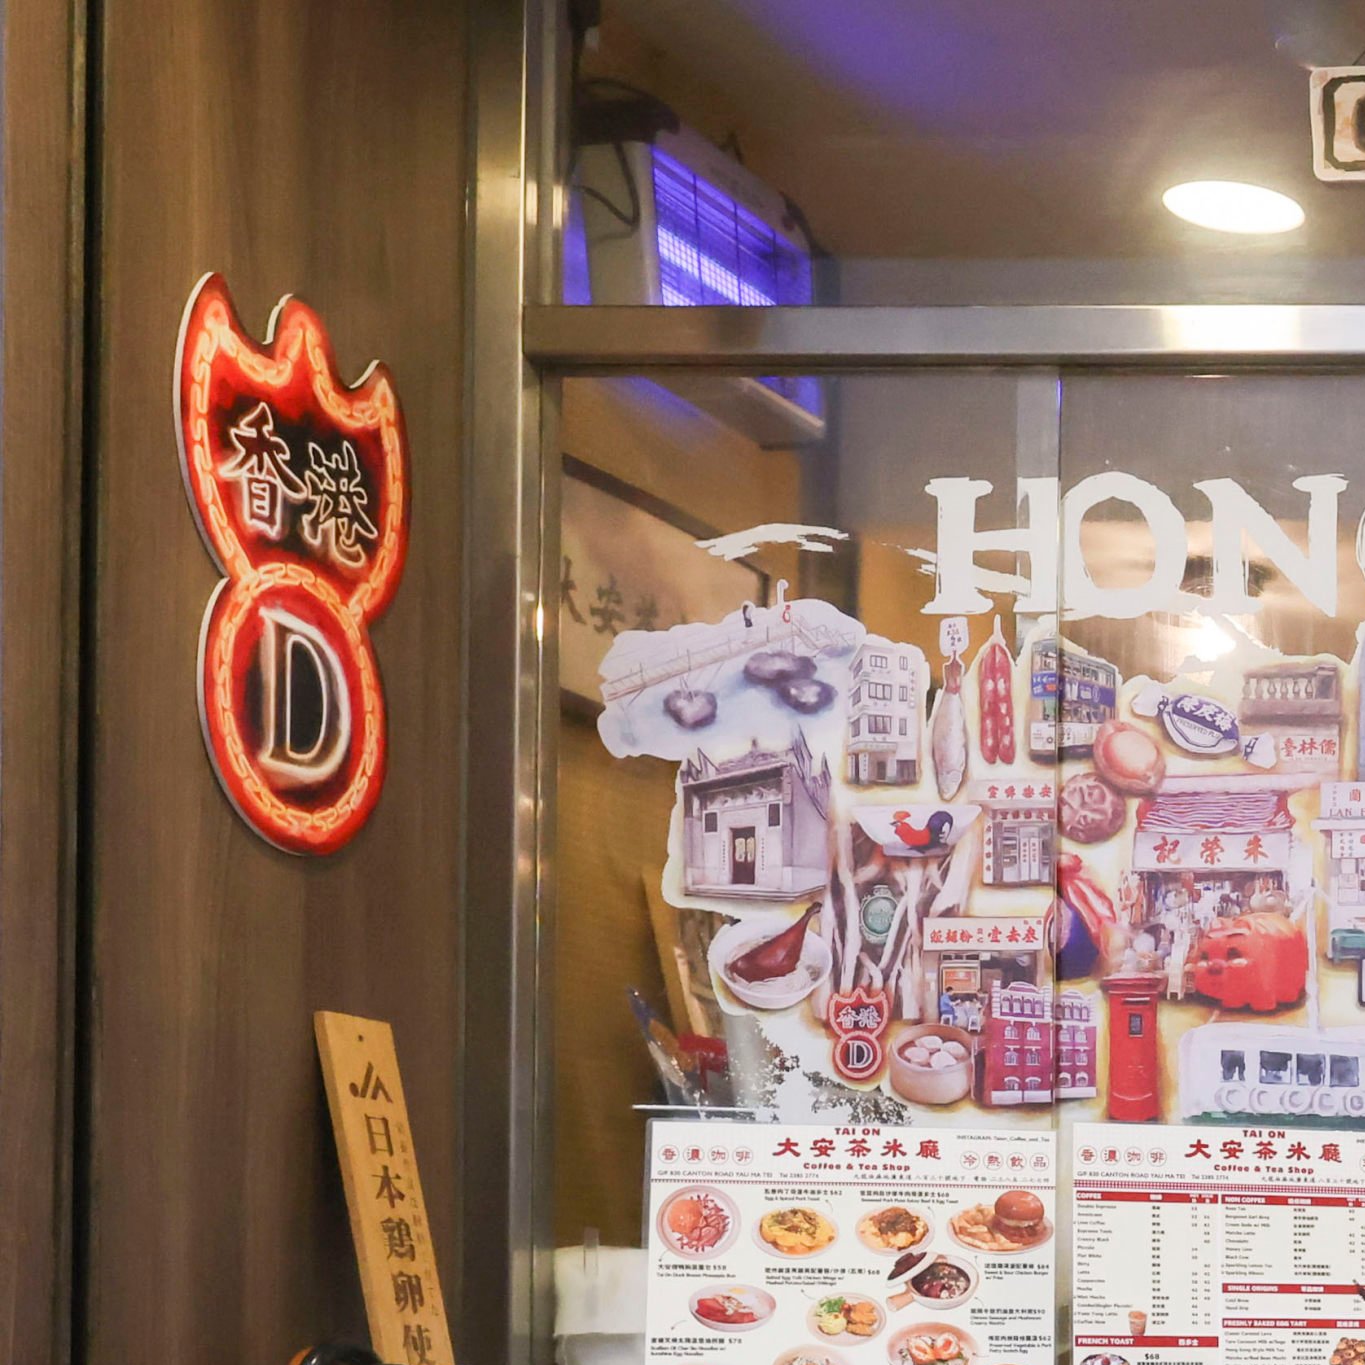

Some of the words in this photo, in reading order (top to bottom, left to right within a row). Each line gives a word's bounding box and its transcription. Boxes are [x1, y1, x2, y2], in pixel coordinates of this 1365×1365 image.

[221, 401, 378, 567] 香港
[257, 606, 352, 784] D
[1329, 808, 1352, 817] LAN
[848, 1038, 872, 1070] D
[834, 1127, 857, 1136] TAI
[861, 1127, 881, 1137] ON
[1242, 1129, 1263, 1139] TAI
[1268, 1130, 1286, 1139] ON
[803, 1162, 842, 1170] Coffee
[846, 1162, 854, 1170] &
[858, 1163, 878, 1171] Tea
[882, 1163, 911, 1172] Shop
[1213, 1164, 1250, 1173] Coffee
[1253, 1165, 1261, 1173] &
[1265, 1166, 1284, 1174] Tea
[1288, 1167, 1315, 1176] Shop
[1077, 1337, 1109, 1346] FRENCH
[1109, 1338, 1136, 1346] TOAST
